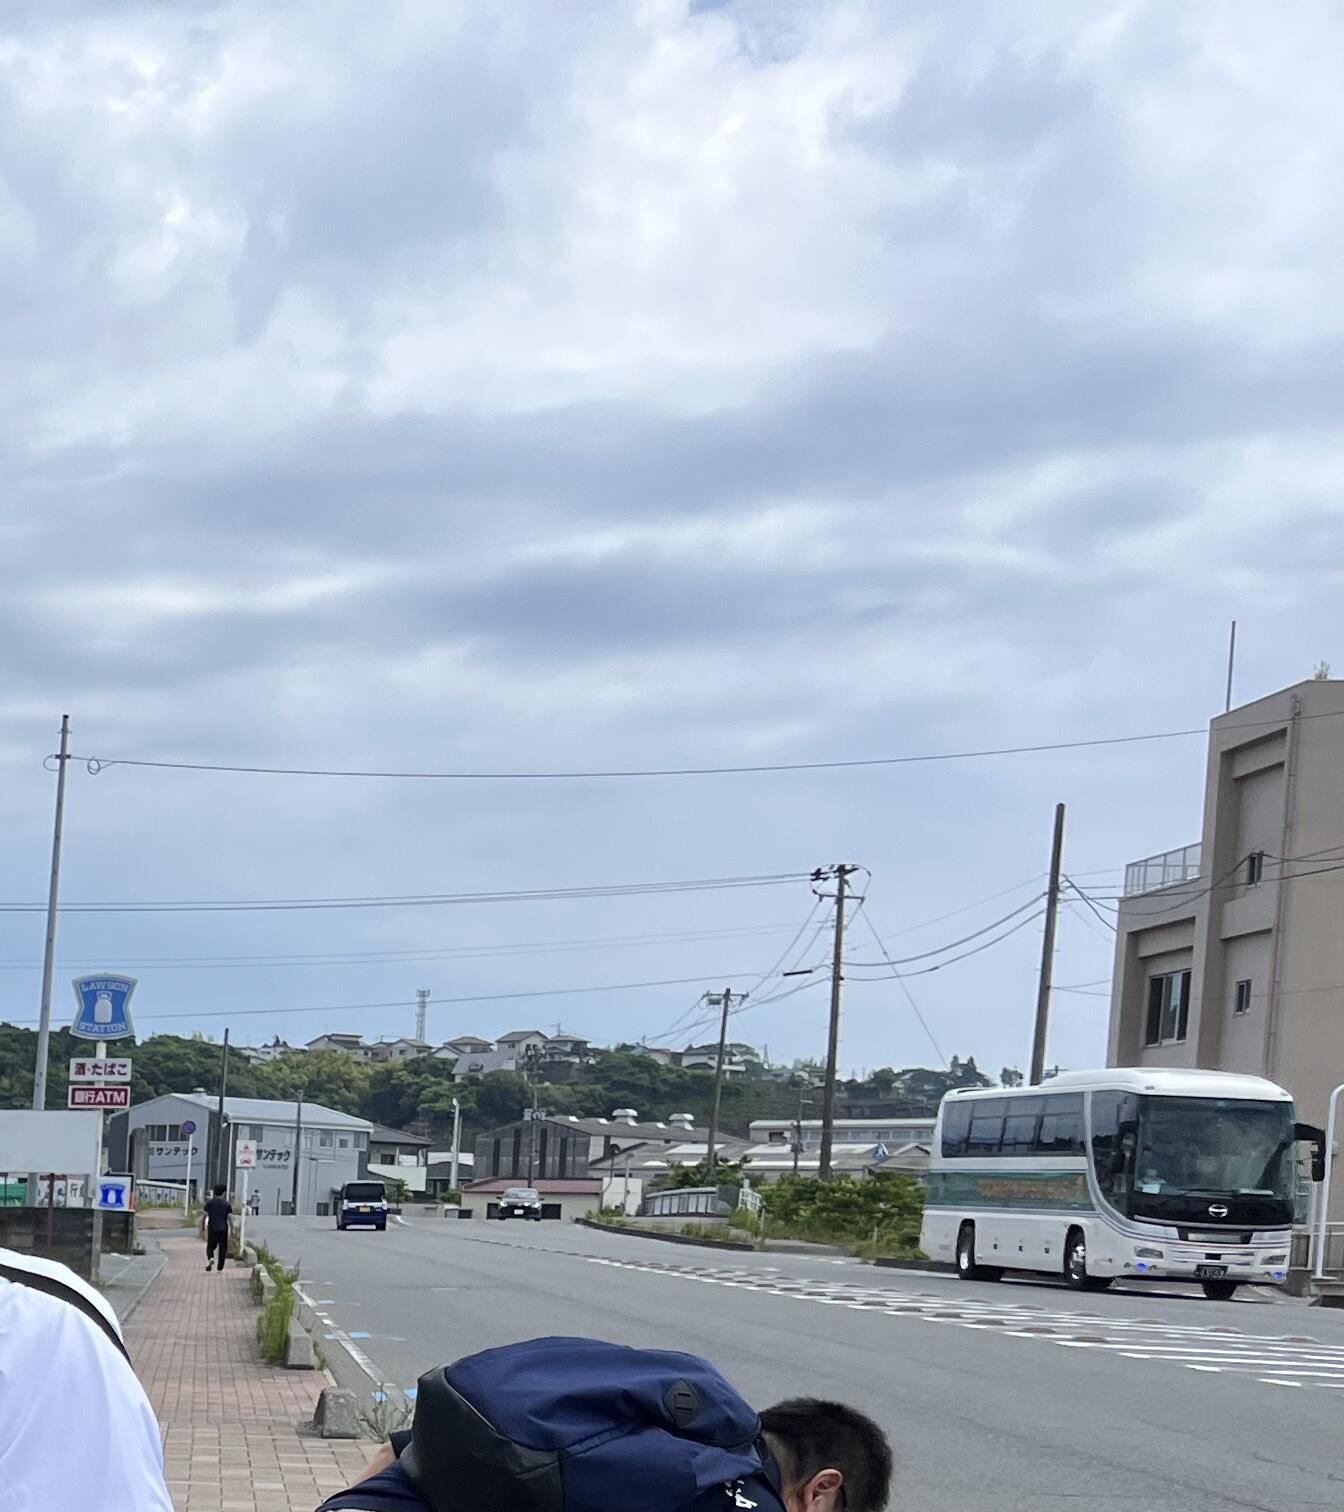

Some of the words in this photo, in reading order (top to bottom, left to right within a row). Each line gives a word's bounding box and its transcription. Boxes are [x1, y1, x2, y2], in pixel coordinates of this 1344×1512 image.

[81, 981, 129, 993] LAWSON
[79, 1021, 128, 1034] STATION
[74, 1090, 126, 1104] 銀行ATM
